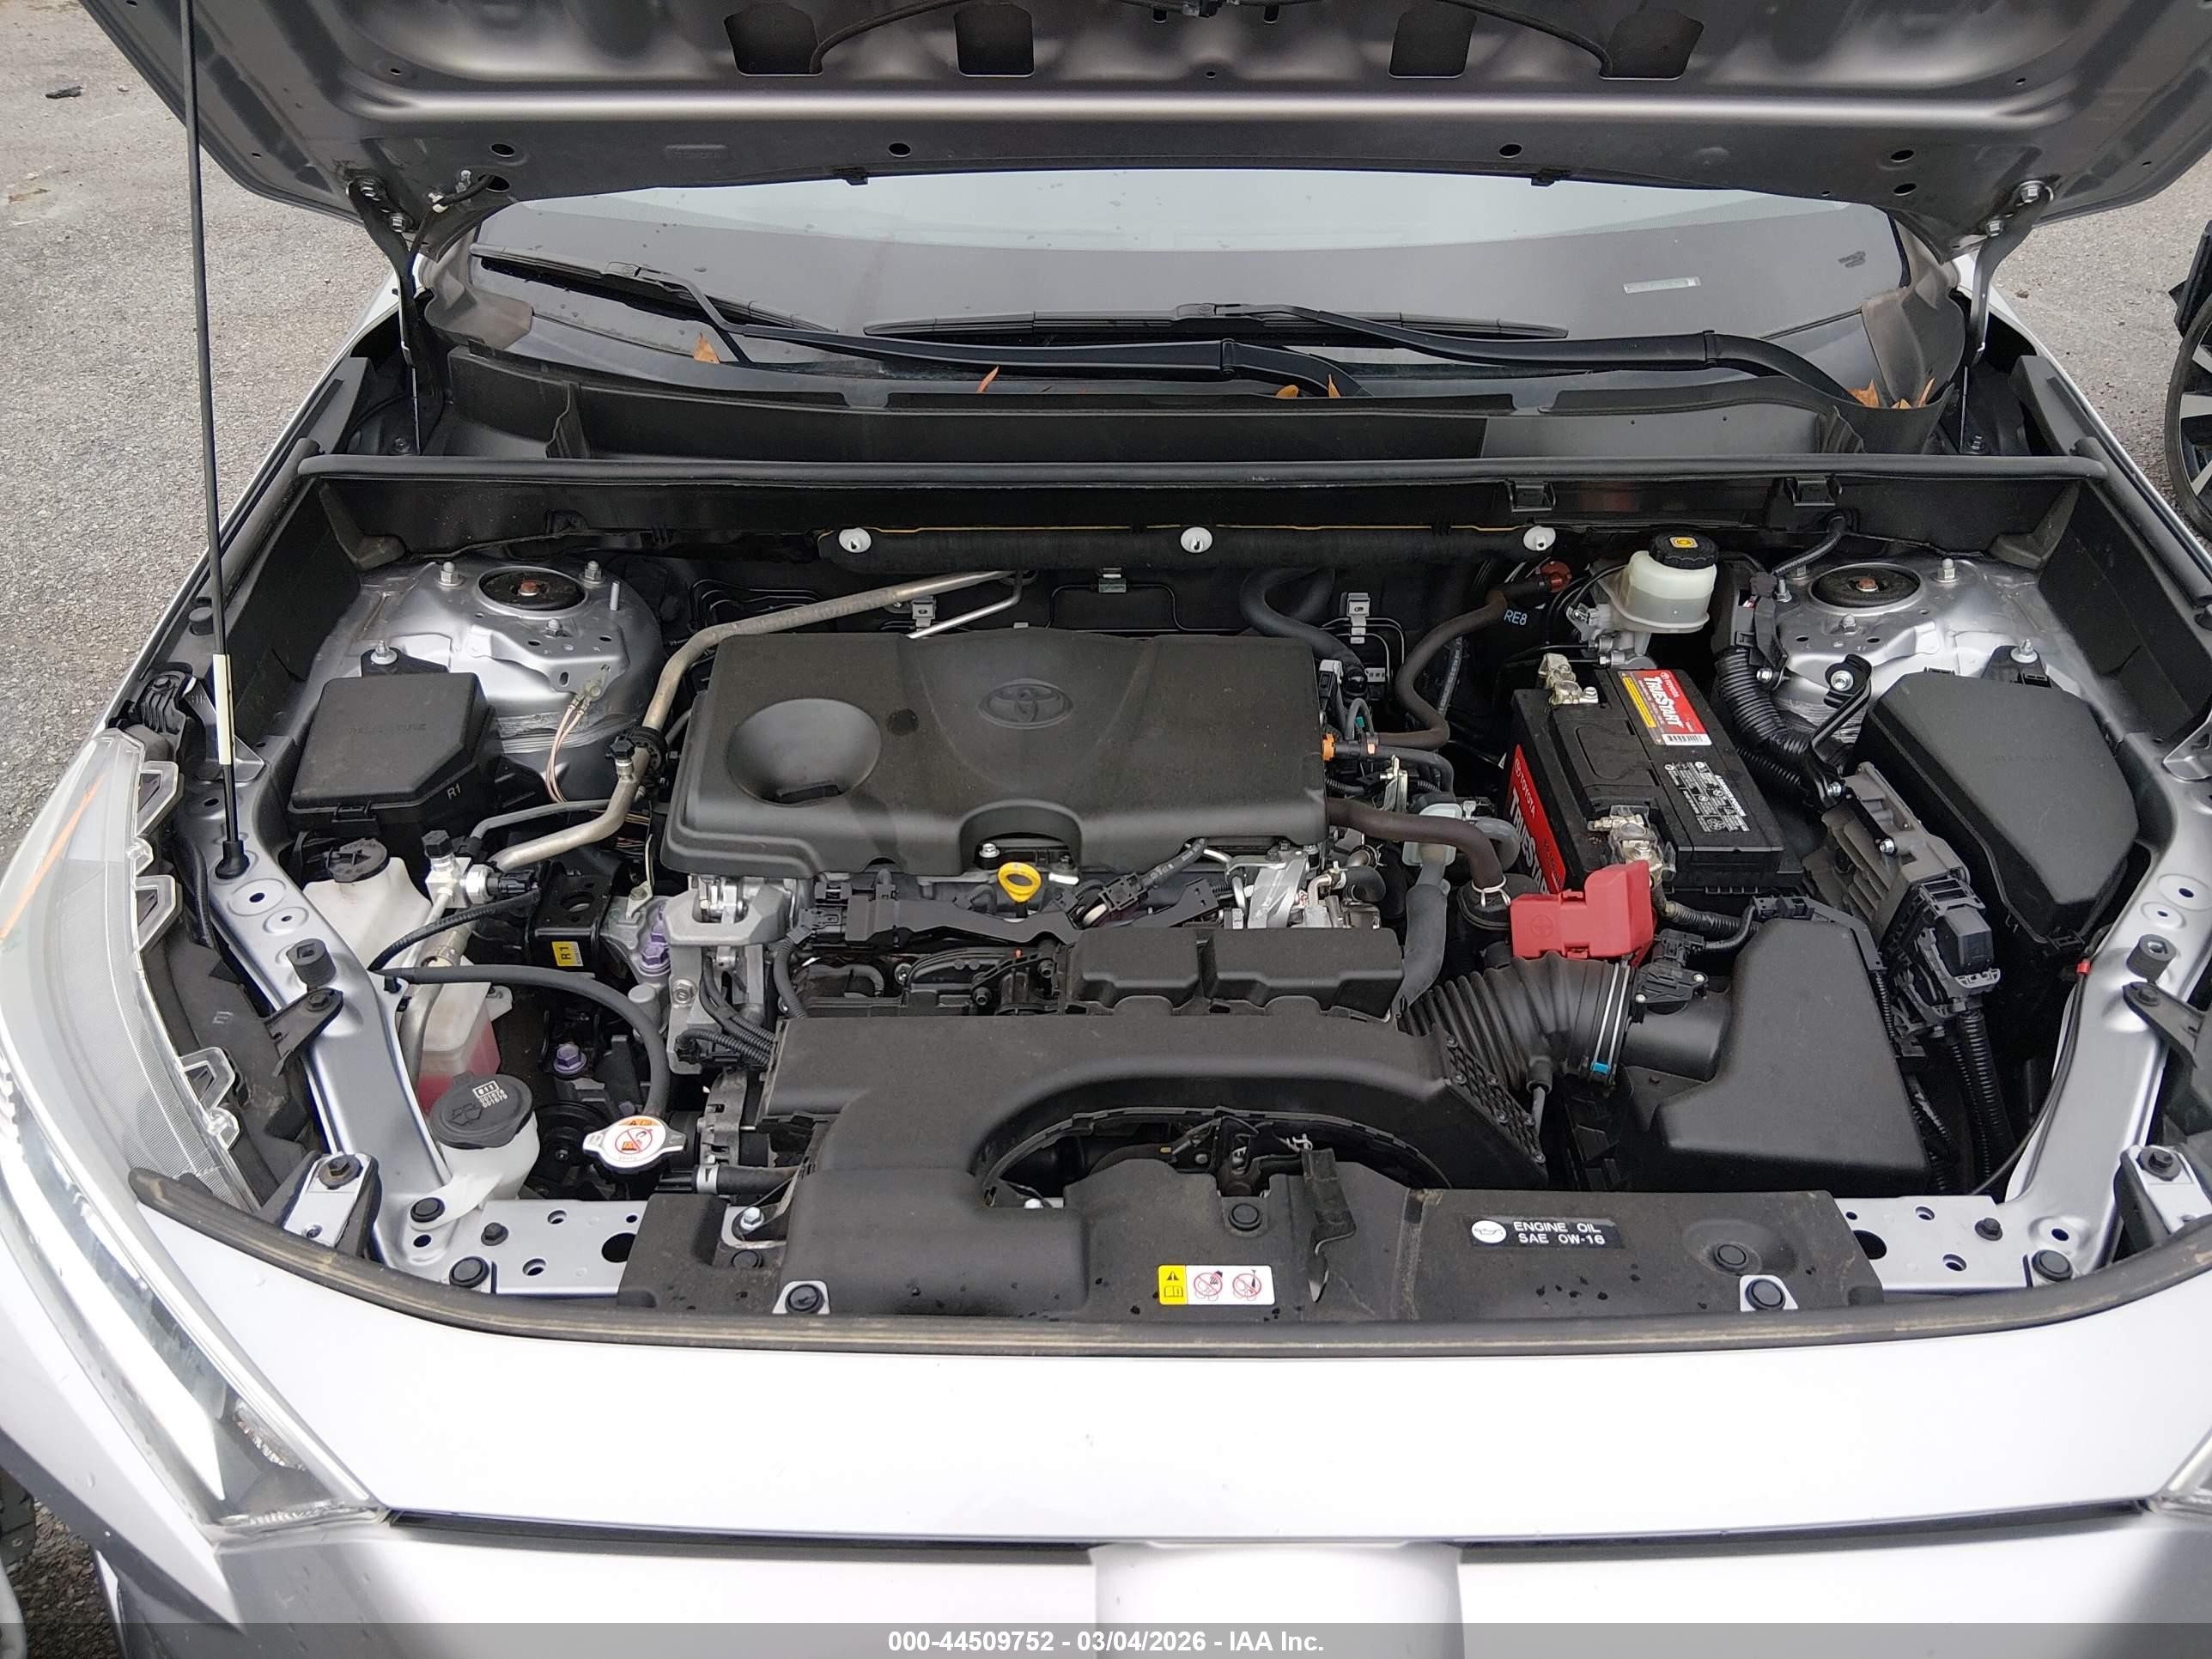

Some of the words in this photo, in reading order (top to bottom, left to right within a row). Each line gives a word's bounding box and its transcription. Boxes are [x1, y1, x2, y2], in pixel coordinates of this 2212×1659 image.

[1504, 609, 1528, 626] RE8
[1665, 679, 1680, 698] TOYOTA
[447, 782, 461, 800] R1
[1519, 774, 1535, 818] TOYOTA
[1510, 786, 1550, 895] TRUESTAR
[1513, 1221, 1568, 1233] ENGINE
[1577, 1222, 1601, 1233] OIL
[1518, 1233, 1549, 1244] SAE
[1558, 1234, 1606, 1245] 0W-16
